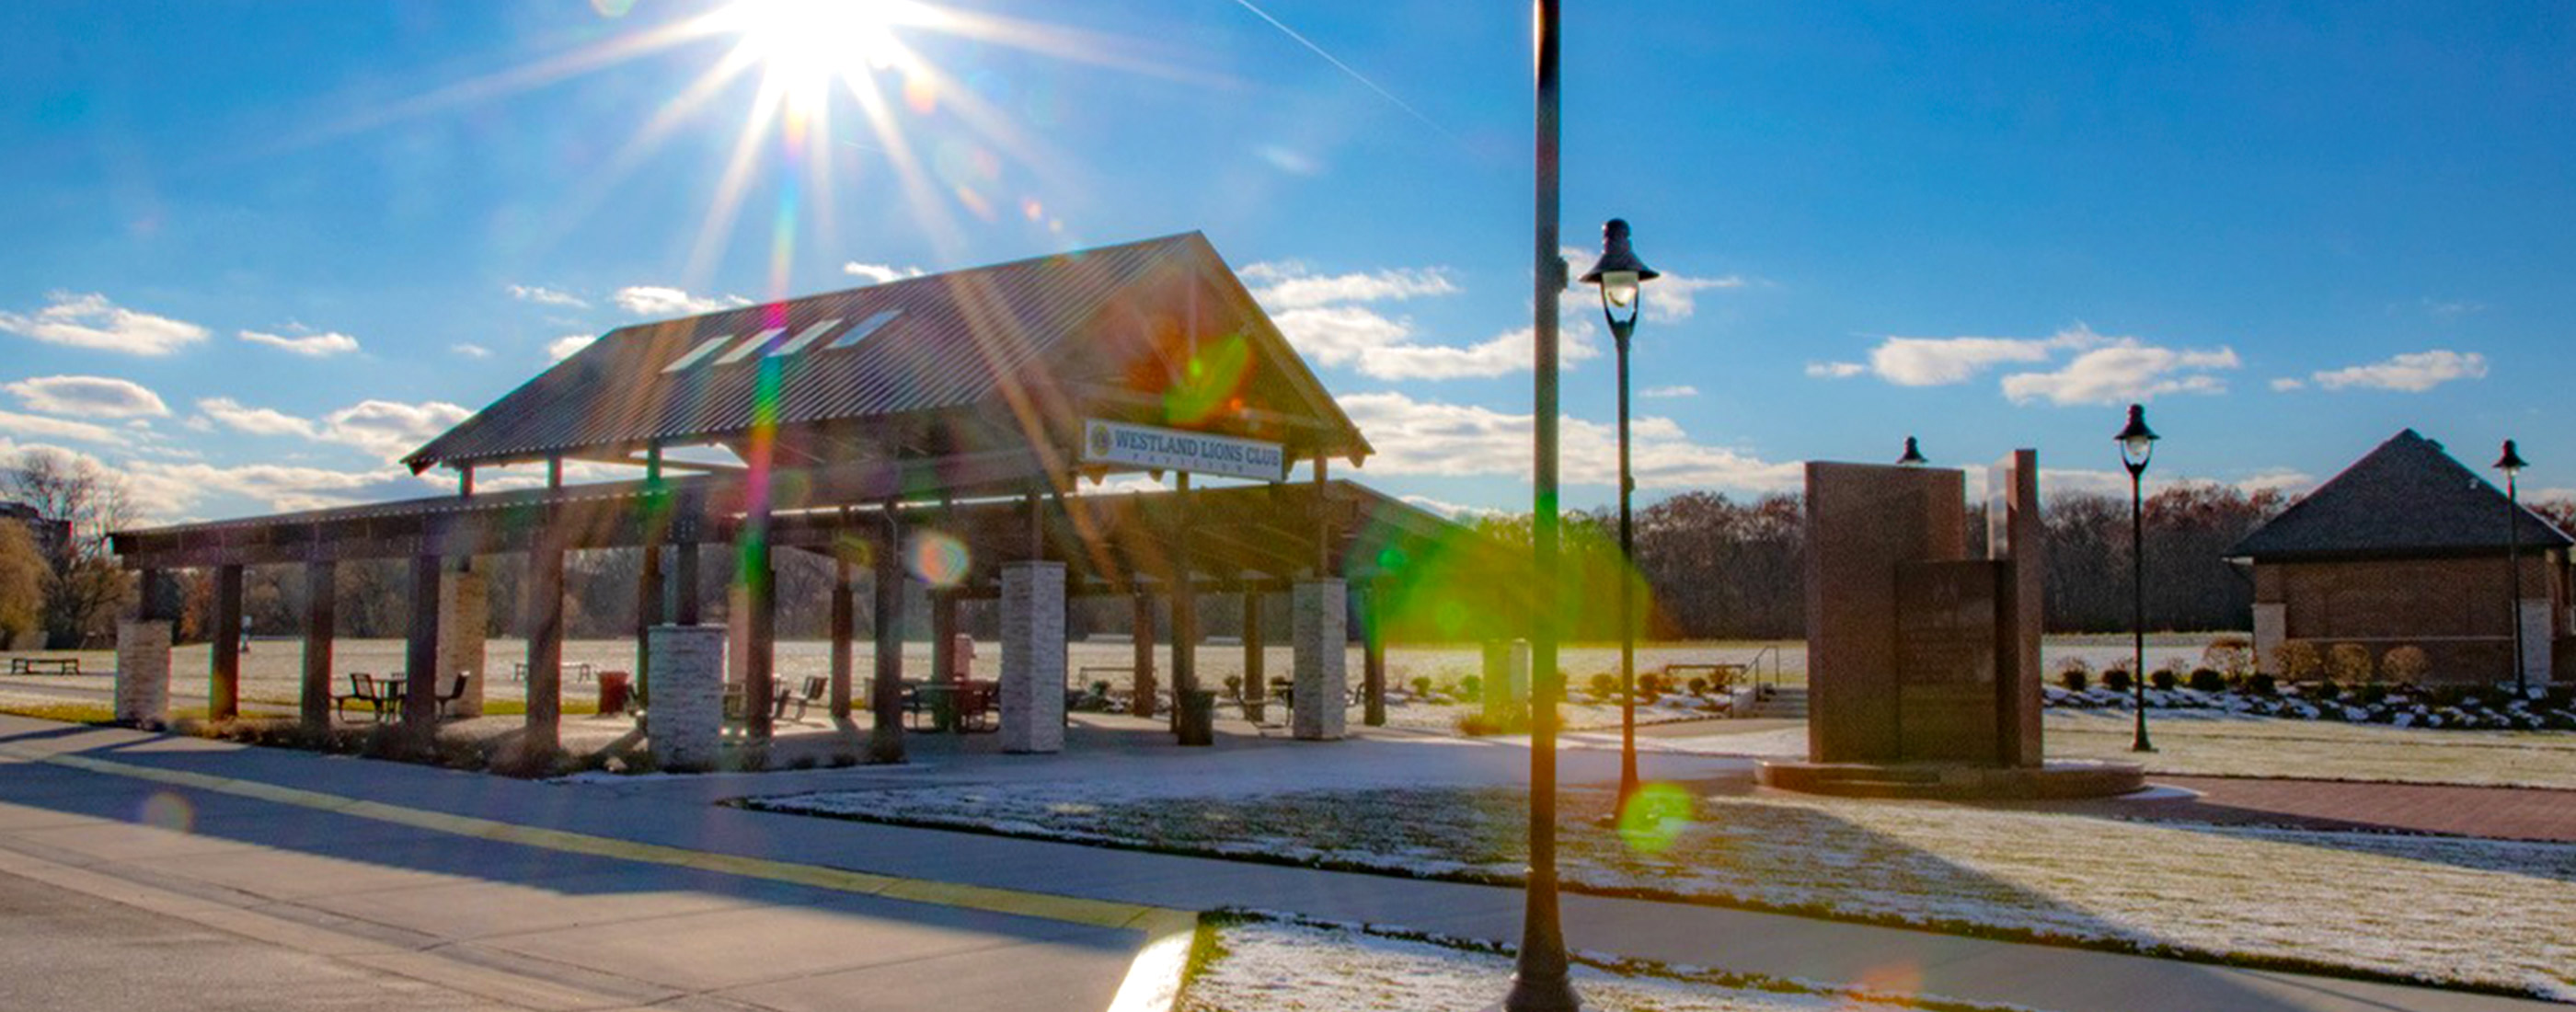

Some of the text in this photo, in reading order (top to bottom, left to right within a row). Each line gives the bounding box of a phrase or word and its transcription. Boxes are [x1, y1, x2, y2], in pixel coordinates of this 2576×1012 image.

[1115, 429, 1280, 466] WESTLAND LIONS CLUB
